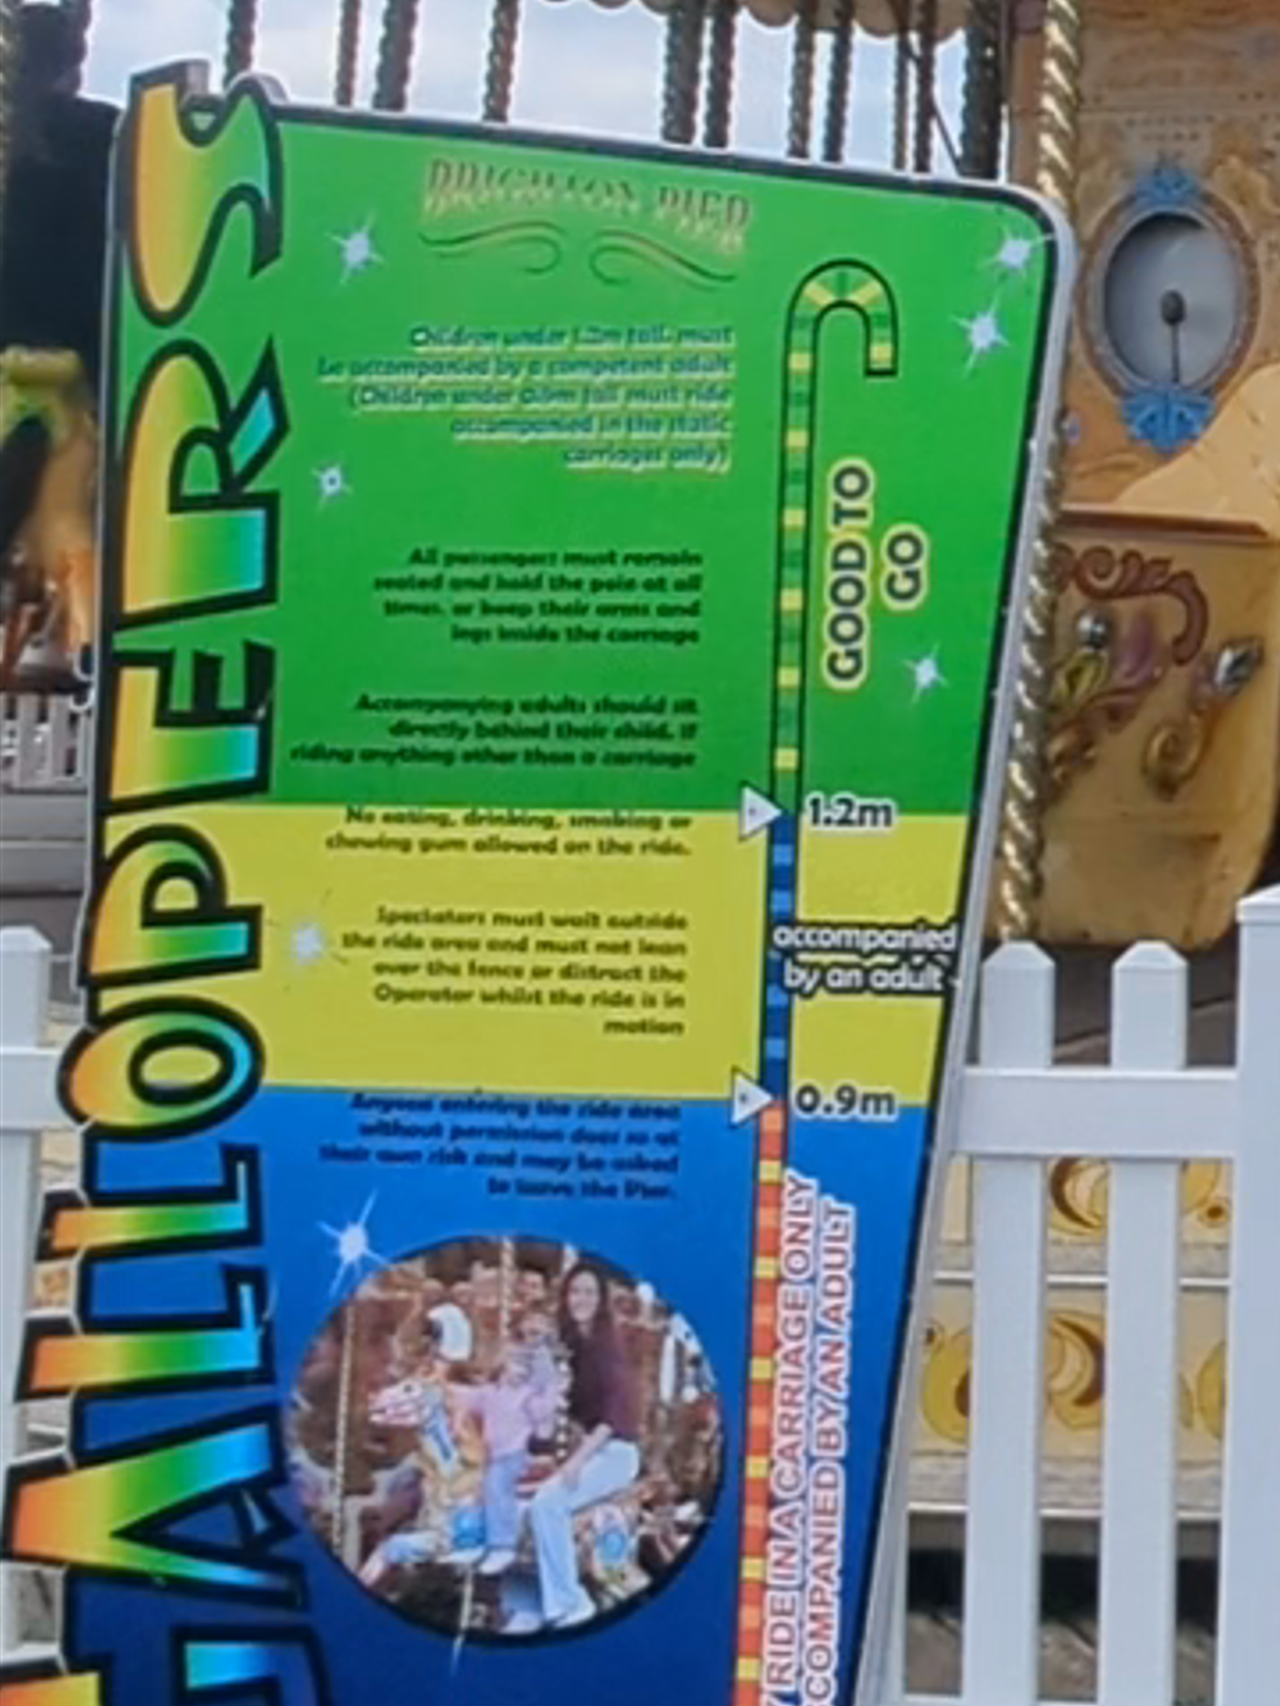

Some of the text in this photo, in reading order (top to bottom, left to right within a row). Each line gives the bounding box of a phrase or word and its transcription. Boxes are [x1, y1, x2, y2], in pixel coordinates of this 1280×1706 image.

[503, 328, 568, 346] under
[677, 328, 733, 346] must
[349, 358, 489, 383] accompanied
[495, 358, 524, 382] by
[547, 359, 665, 384] competent
[669, 358, 732, 376] adult
[453, 389, 516, 407] under
[625, 389, 682, 407] must
[686, 387, 732, 405] ride
[451, 418, 594, 441] accompanied
[625, 416, 663, 436] the
[409, 549, 703, 570] All passengers must remain
[886, 530, 926, 603] GO
[374, 574, 443, 591] seated
[449, 575, 489, 591] and
[496, 574, 543, 591] hold
[549, 575, 585, 591] the
[641, 577, 669, 591] at
[674, 574, 703, 591] all
[825, 465, 871, 681] GOOD TO
[452, 602, 475, 617] or
[539, 600, 590, 617] their
[595, 602, 650, 617] arms
[655, 600, 701, 617] and
[497, 626, 559, 642] inside
[566, 626, 600, 643] the
[607, 627, 700, 647] carriage
[357, 693, 698, 717] Accompanying adults should sit
[389, 721, 470, 741] directly
[474, 721, 551, 739] behind
[556, 722, 607, 739] their
[291, 744, 697, 769] riding anything other than a carriage
[345, 806, 375, 824] No
[569, 812, 662, 831] smoking
[669, 815, 692, 830] or
[806, 795, 894, 828] 1.2m
[326, 835, 691, 856] chewing gum allowed on the ride.
[375, 906, 688, 931] Spectators must wait outside
[342, 932, 687, 956] the ride area and must not lean
[773, 924, 956, 955] accompanied
[373, 959, 686, 983] over the fence or distract the
[783, 962, 945, 994] by an adult
[373, 985, 685, 1008] Operator whilst the ride is in
[603, 1017, 685, 1035] motion
[439, 1098, 530, 1119] entering
[536, 1101, 571, 1118] the
[578, 1102, 621, 1119] ride
[628, 1105, 681, 1120] area
[795, 1084, 897, 1118] 0.9m
[359, 1121, 444, 1138] without
[450, 1126, 564, 1142] permission
[319, 1144, 680, 1173] their own risk and may be asked
[487, 1179, 511, 1195] to
[516, 1179, 574, 1197] leave
[580, 1180, 618, 1198] the
[783, 1172, 815, 1281] ONLY
[819, 1197, 853, 1329] ADULT
[818, 1336, 849, 1396] AN
[774, 1286, 811, 1497] CARRIAGE
[815, 1398, 846, 1456] BY
[772, 1504, 802, 1533] A
[770, 1536, 800, 1584] IN
[766, 1593, 798, 1686] RIDE
